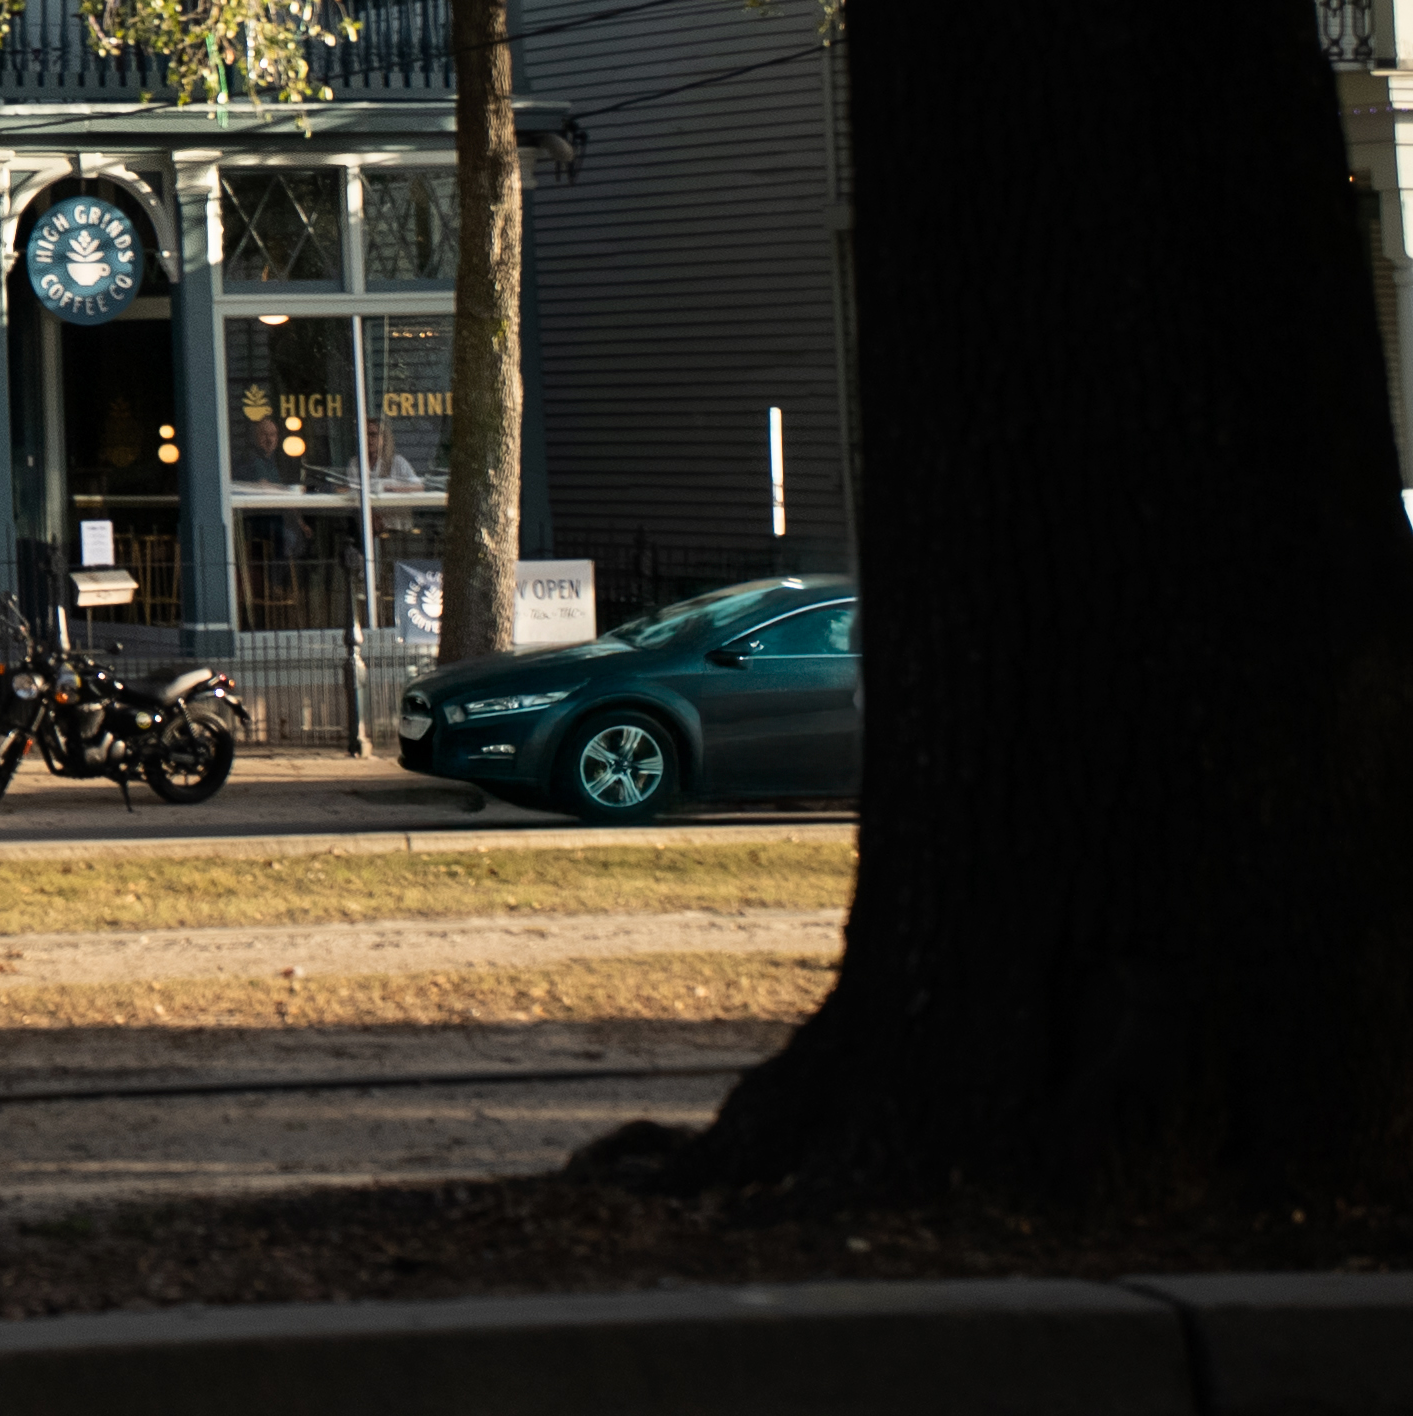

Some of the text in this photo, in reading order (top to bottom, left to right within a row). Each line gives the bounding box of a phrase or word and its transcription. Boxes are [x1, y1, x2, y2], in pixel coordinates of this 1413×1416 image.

[35, 204, 135, 263] HIGH GRINDS
[41, 273, 133, 316] COFFEE CO
[279, 393, 343, 418] HIGH
[532, 578, 582, 600] OPEN
